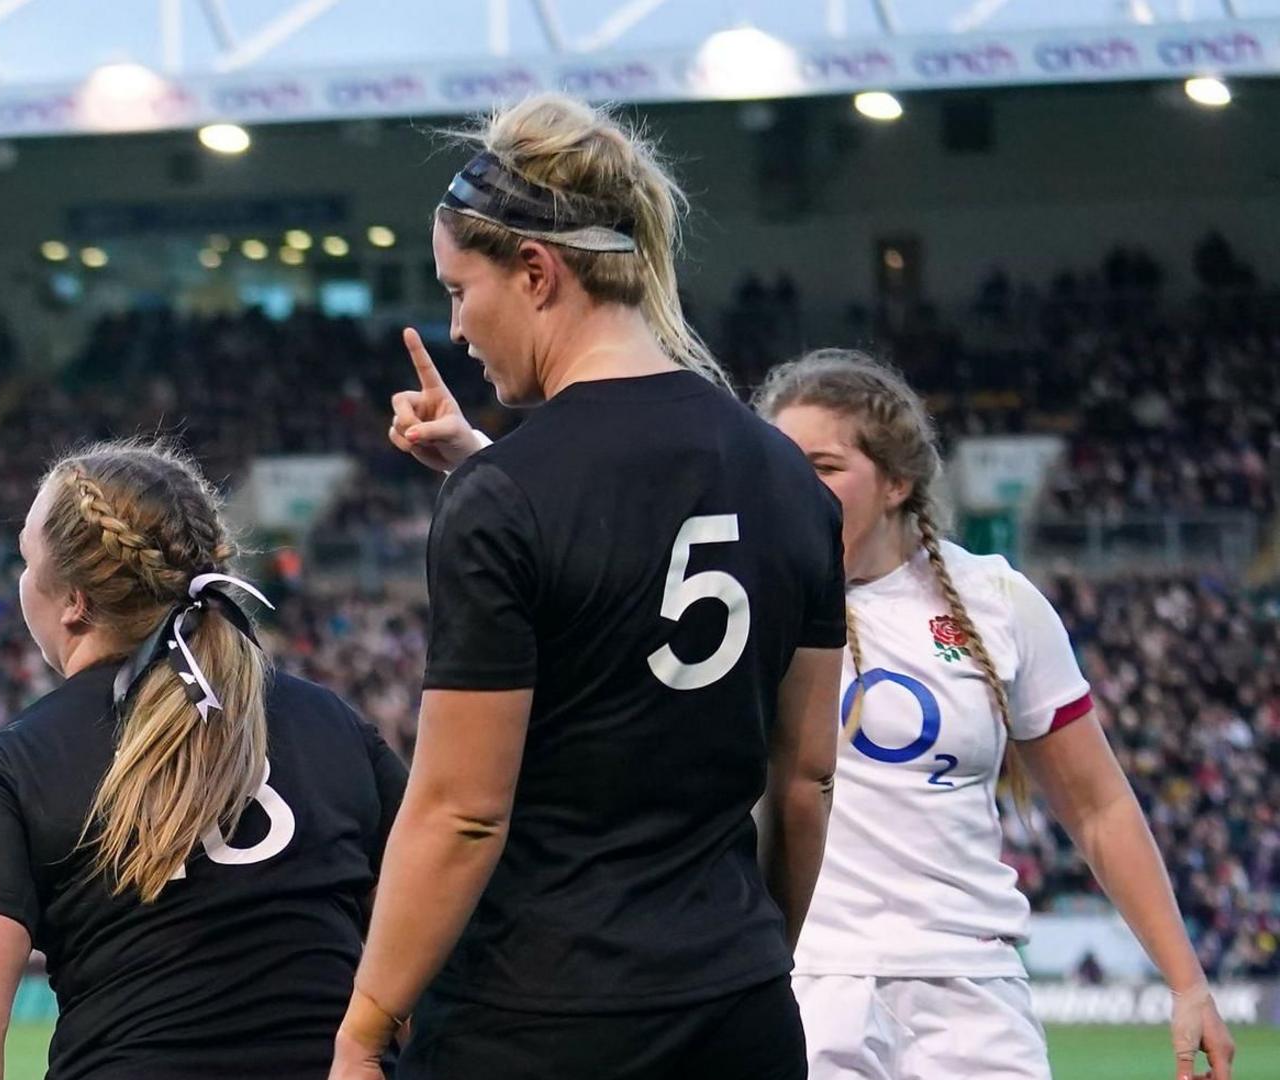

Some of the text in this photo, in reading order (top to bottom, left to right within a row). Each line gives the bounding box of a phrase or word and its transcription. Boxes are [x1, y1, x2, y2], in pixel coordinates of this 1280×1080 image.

[913, 44, 1018, 78] cinch
[1034, 37, 1140, 71] cinch
[1156, 31, 1262, 67] cinch
[647, 513, 751, 690] 5
[841, 667, 959, 786] O2
